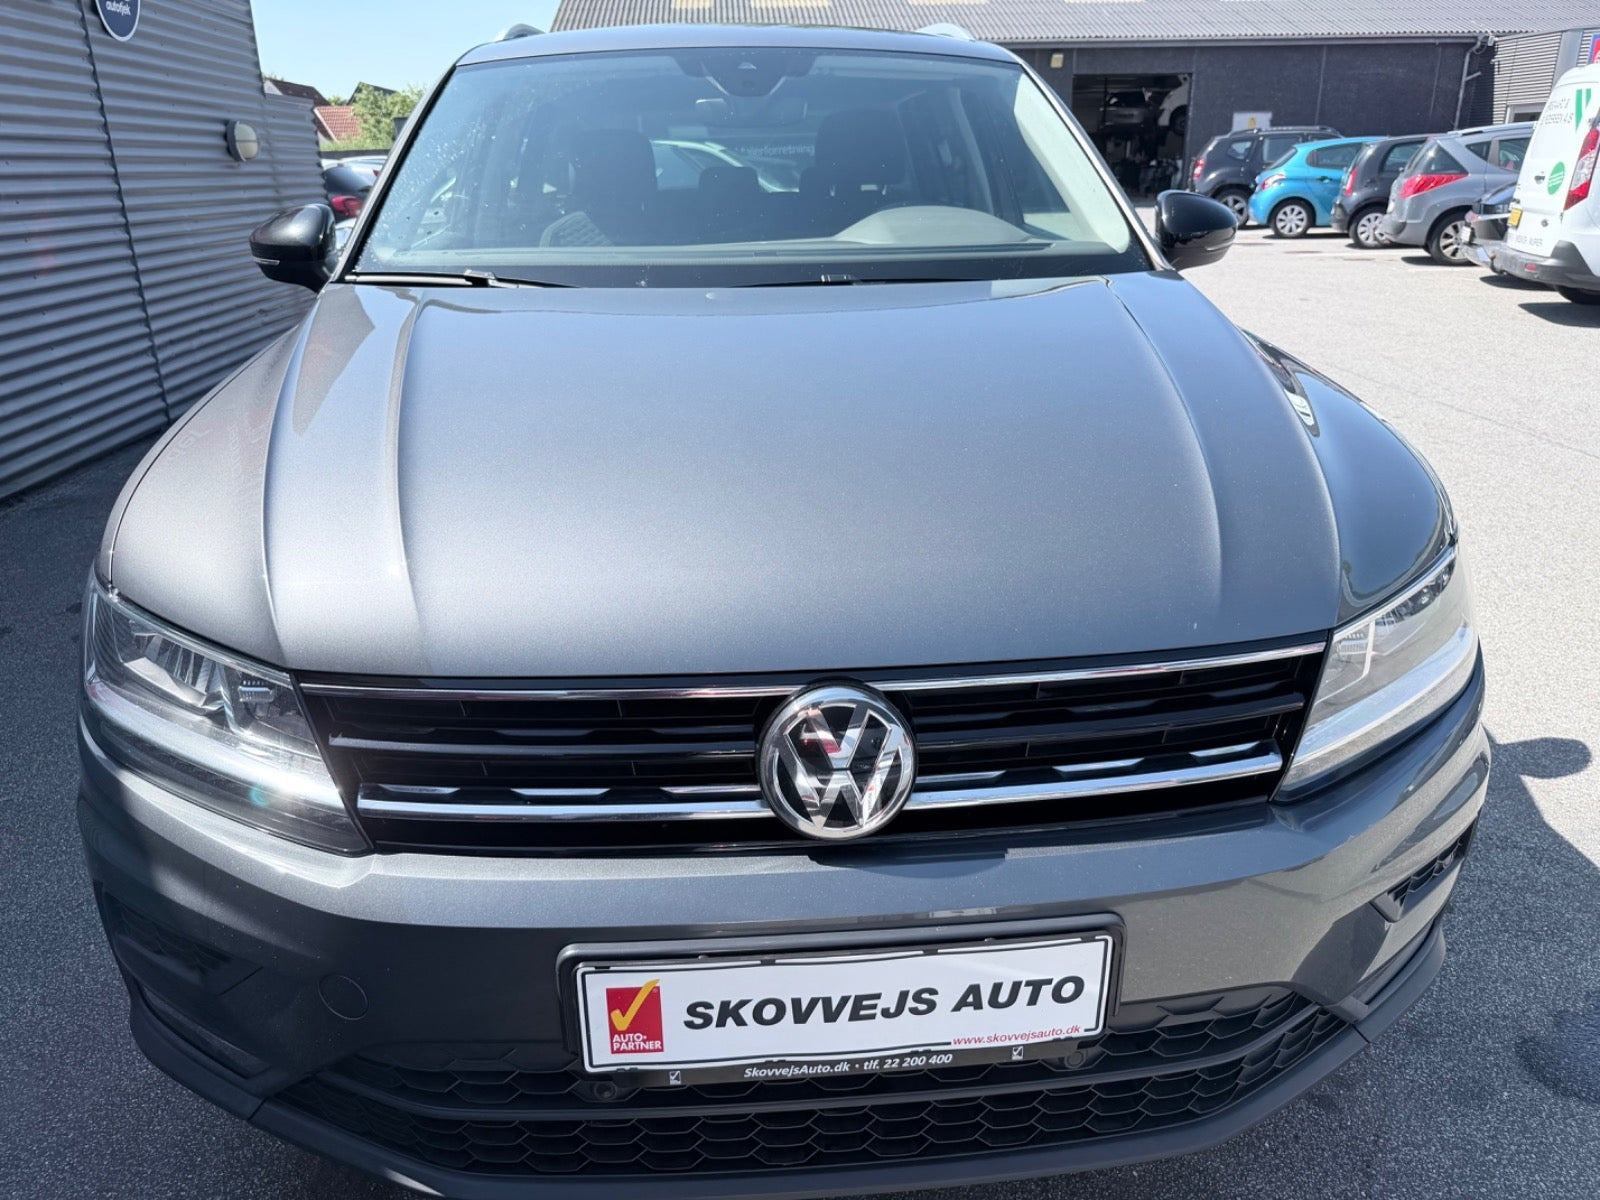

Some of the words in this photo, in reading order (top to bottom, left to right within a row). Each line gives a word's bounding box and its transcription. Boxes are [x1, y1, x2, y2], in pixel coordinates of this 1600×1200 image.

[683, 987, 940, 1030] SKOVVEJS
[951, 975, 1085, 1012] AUTO
[613, 1040, 662, 1051] PARTNER
[953, 1025, 1081, 1045] www.skovvejsauto.dk
[744, 1061, 850, 1079] SkovvejsAuto.dk
[863, 1059, 880, 1071] tlf.
[883, 1058, 899, 1070] 22
[902, 1056, 926, 1068] 200
[928, 1053, 953, 1065] 400
